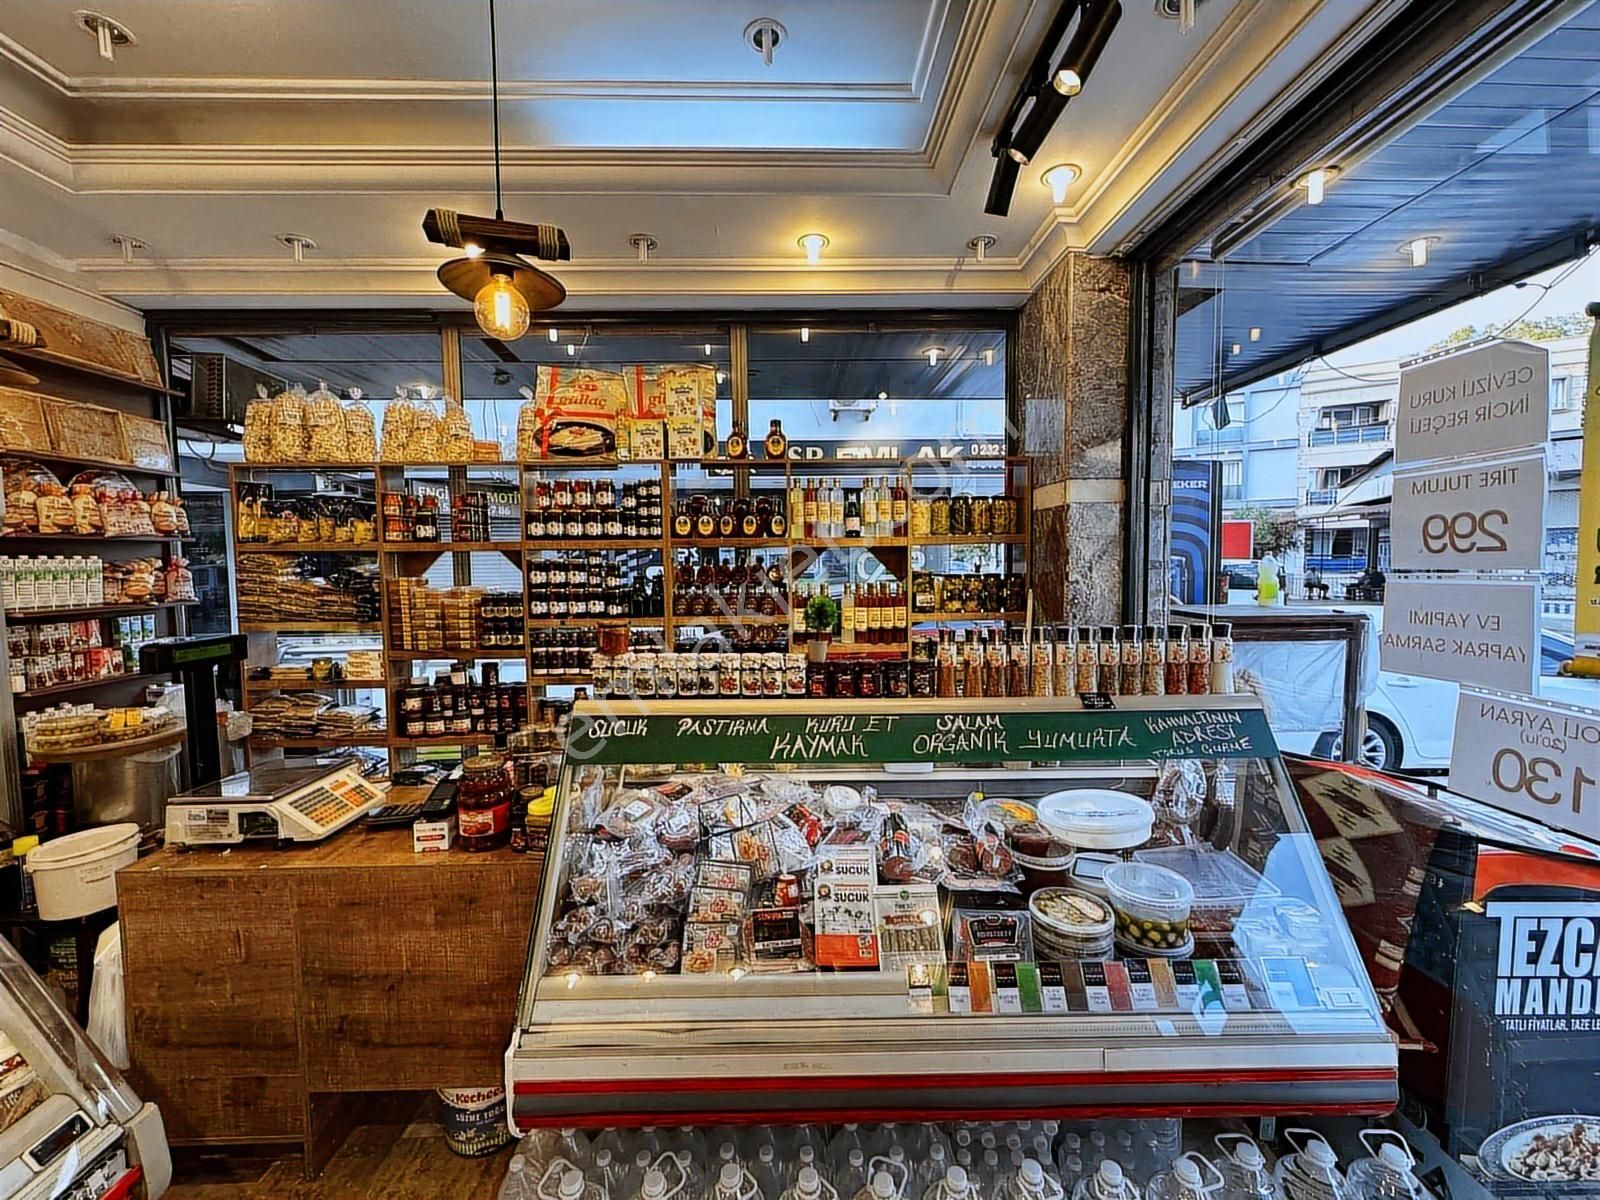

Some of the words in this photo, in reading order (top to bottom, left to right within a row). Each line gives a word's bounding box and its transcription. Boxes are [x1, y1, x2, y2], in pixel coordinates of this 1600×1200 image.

[589, 719, 649, 739] SUCUK
[676, 716, 771, 738] PASTIRMA
[804, 715, 856, 735] KURU
[862, 715, 901, 734] ET
[935, 713, 1004, 732] SALAM
[769, 734, 870, 761] KAYMAK
[912, 731, 1010, 757] ORGANİK
[1018, 724, 1138, 750] YUMURTA
[835, 866, 870, 875] SUCUK
[833, 892, 870, 903] SUCUK
[1486, 901, 1600, 977] TEZC
